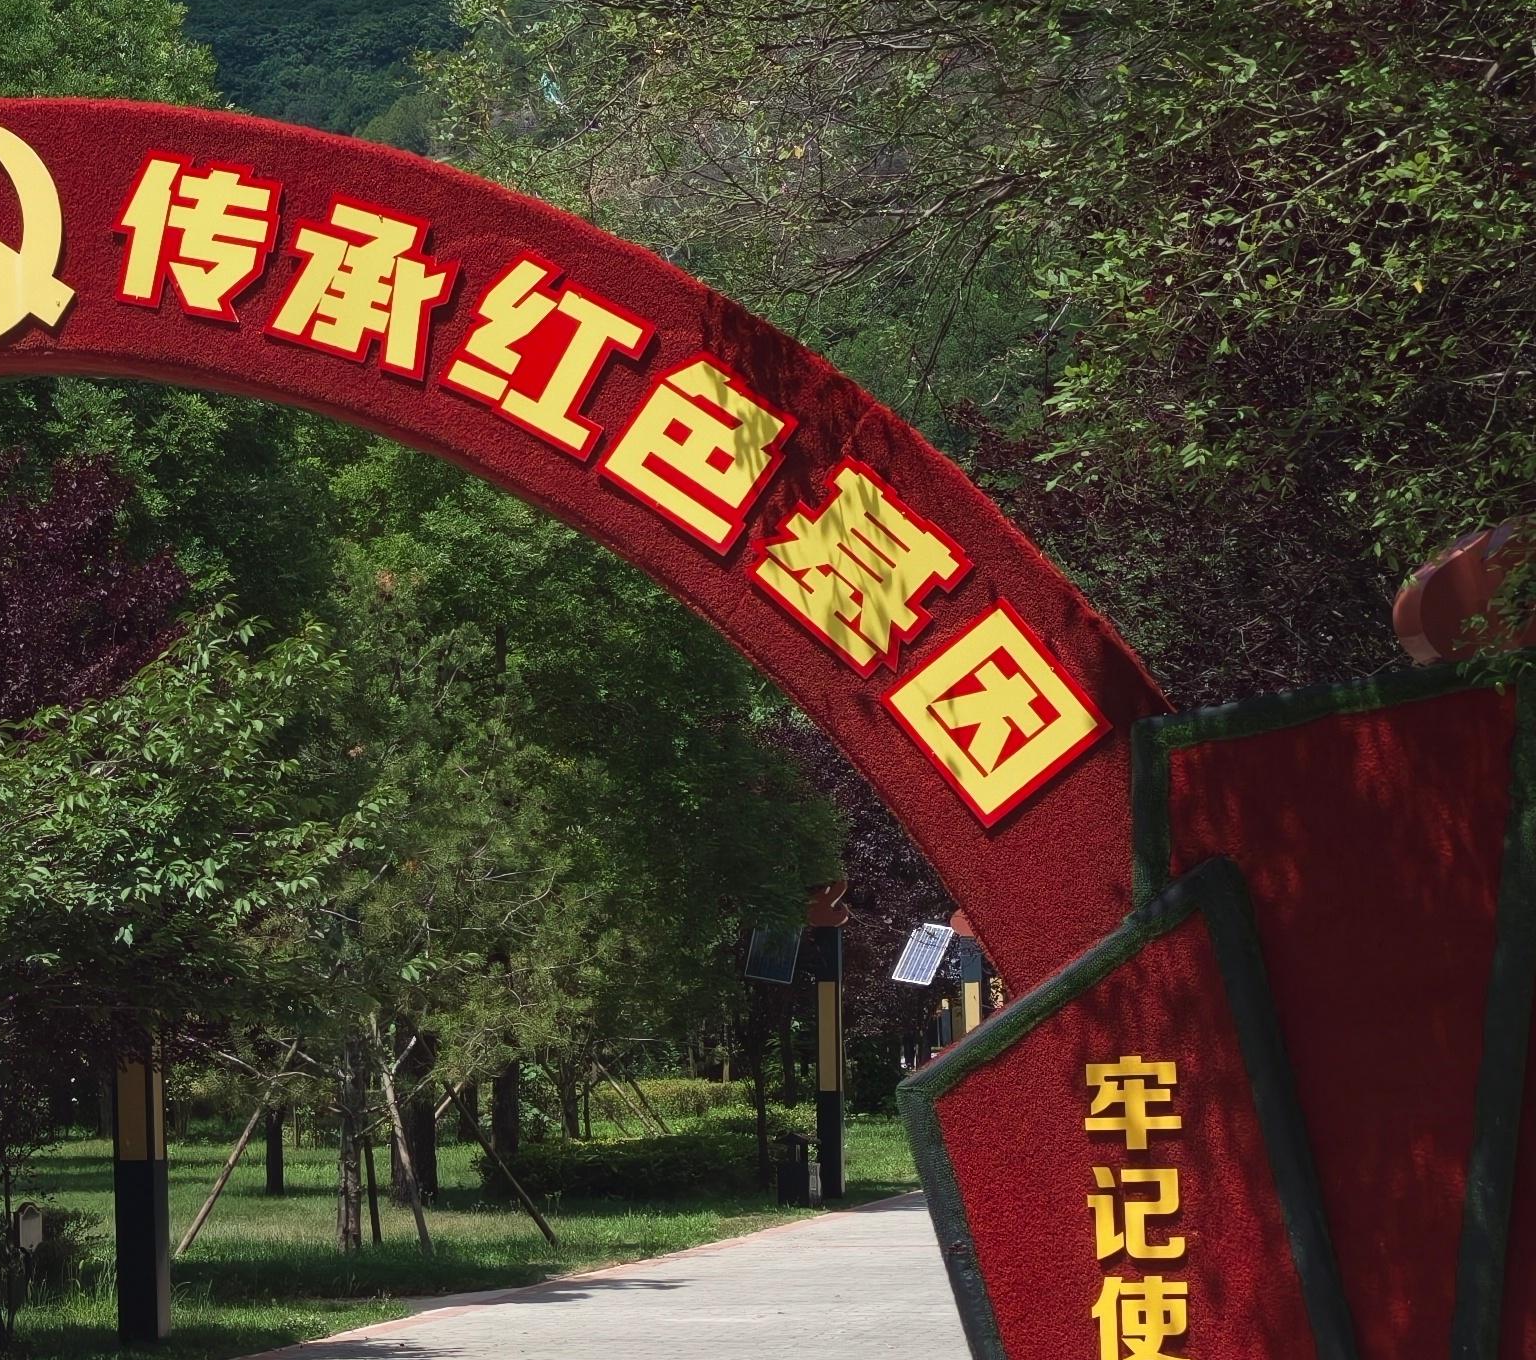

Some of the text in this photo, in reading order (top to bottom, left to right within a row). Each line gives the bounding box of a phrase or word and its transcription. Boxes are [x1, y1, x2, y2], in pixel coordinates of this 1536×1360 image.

[120, 157, 1099, 815] 传承红色基因
